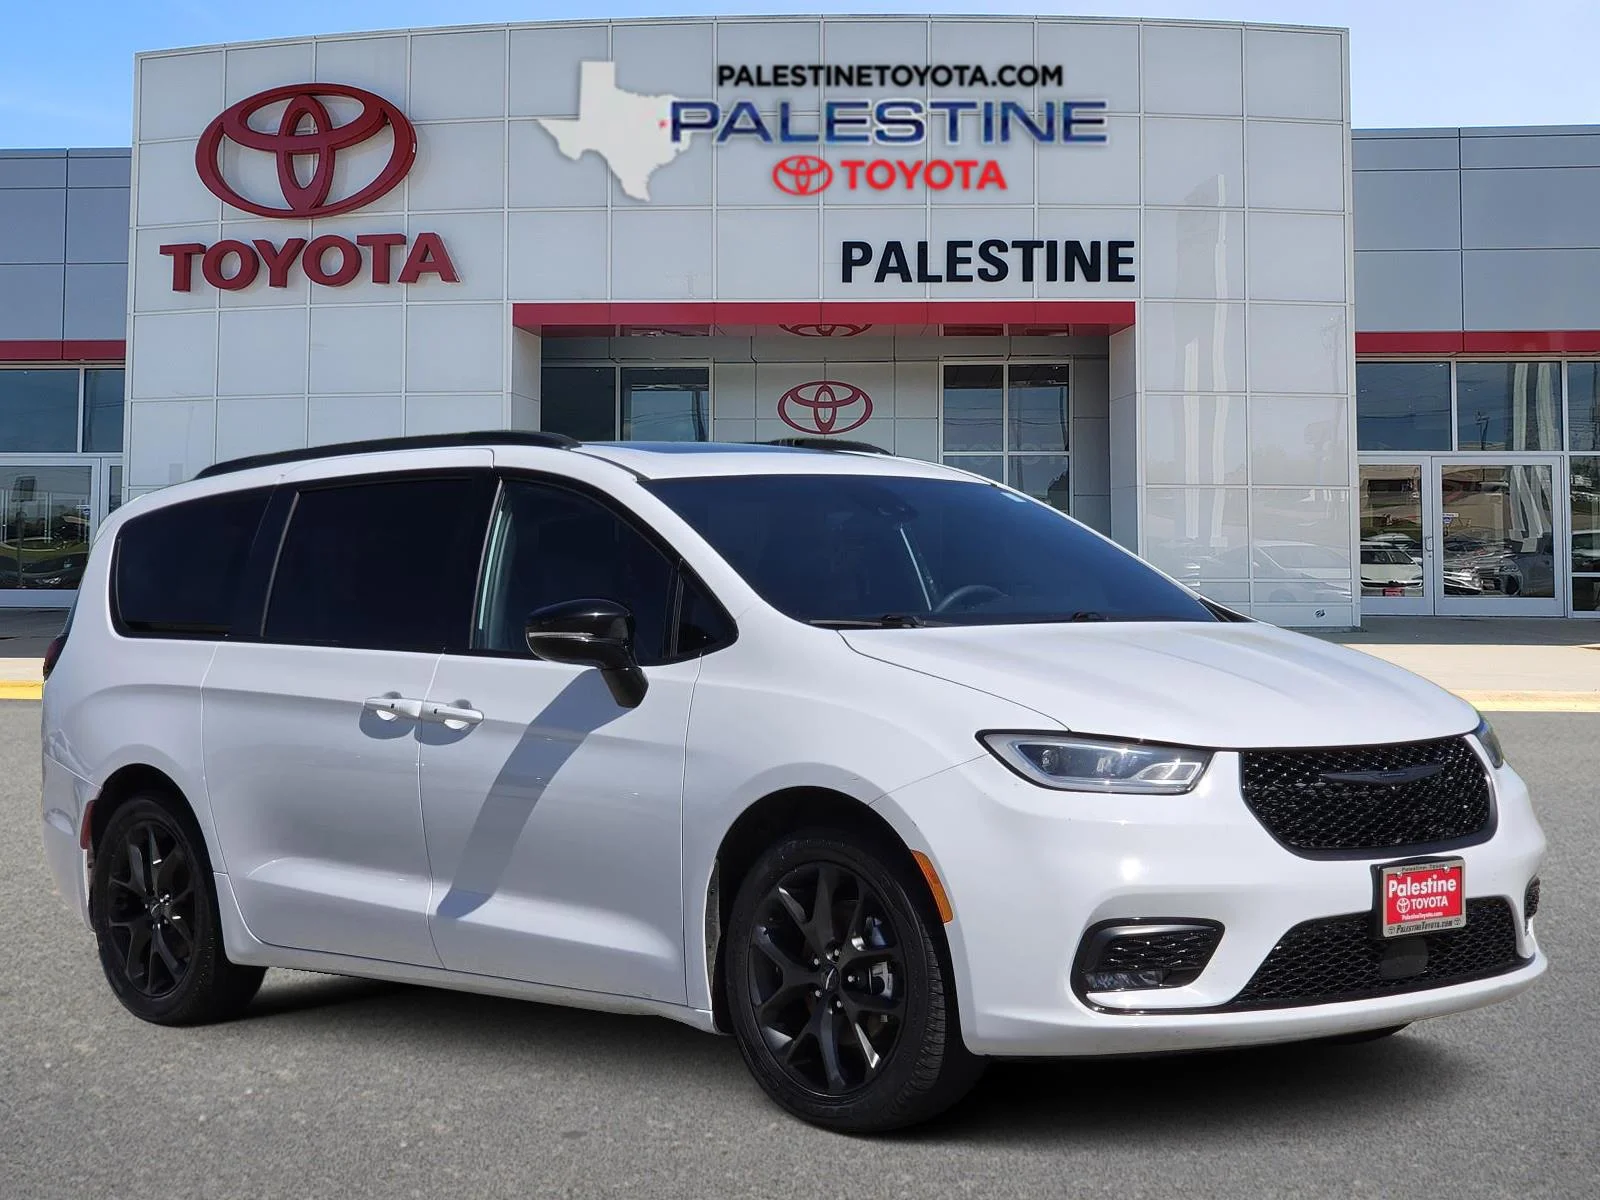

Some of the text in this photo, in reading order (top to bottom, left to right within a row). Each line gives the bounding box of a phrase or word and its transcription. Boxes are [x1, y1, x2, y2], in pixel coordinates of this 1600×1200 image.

[159, 232, 461, 292] TOYOTA
[842, 240, 1136, 283] PALESTINE
[1388, 874, 1457, 897] Palestine
[1411, 896, 1448, 910] TOYOTA
